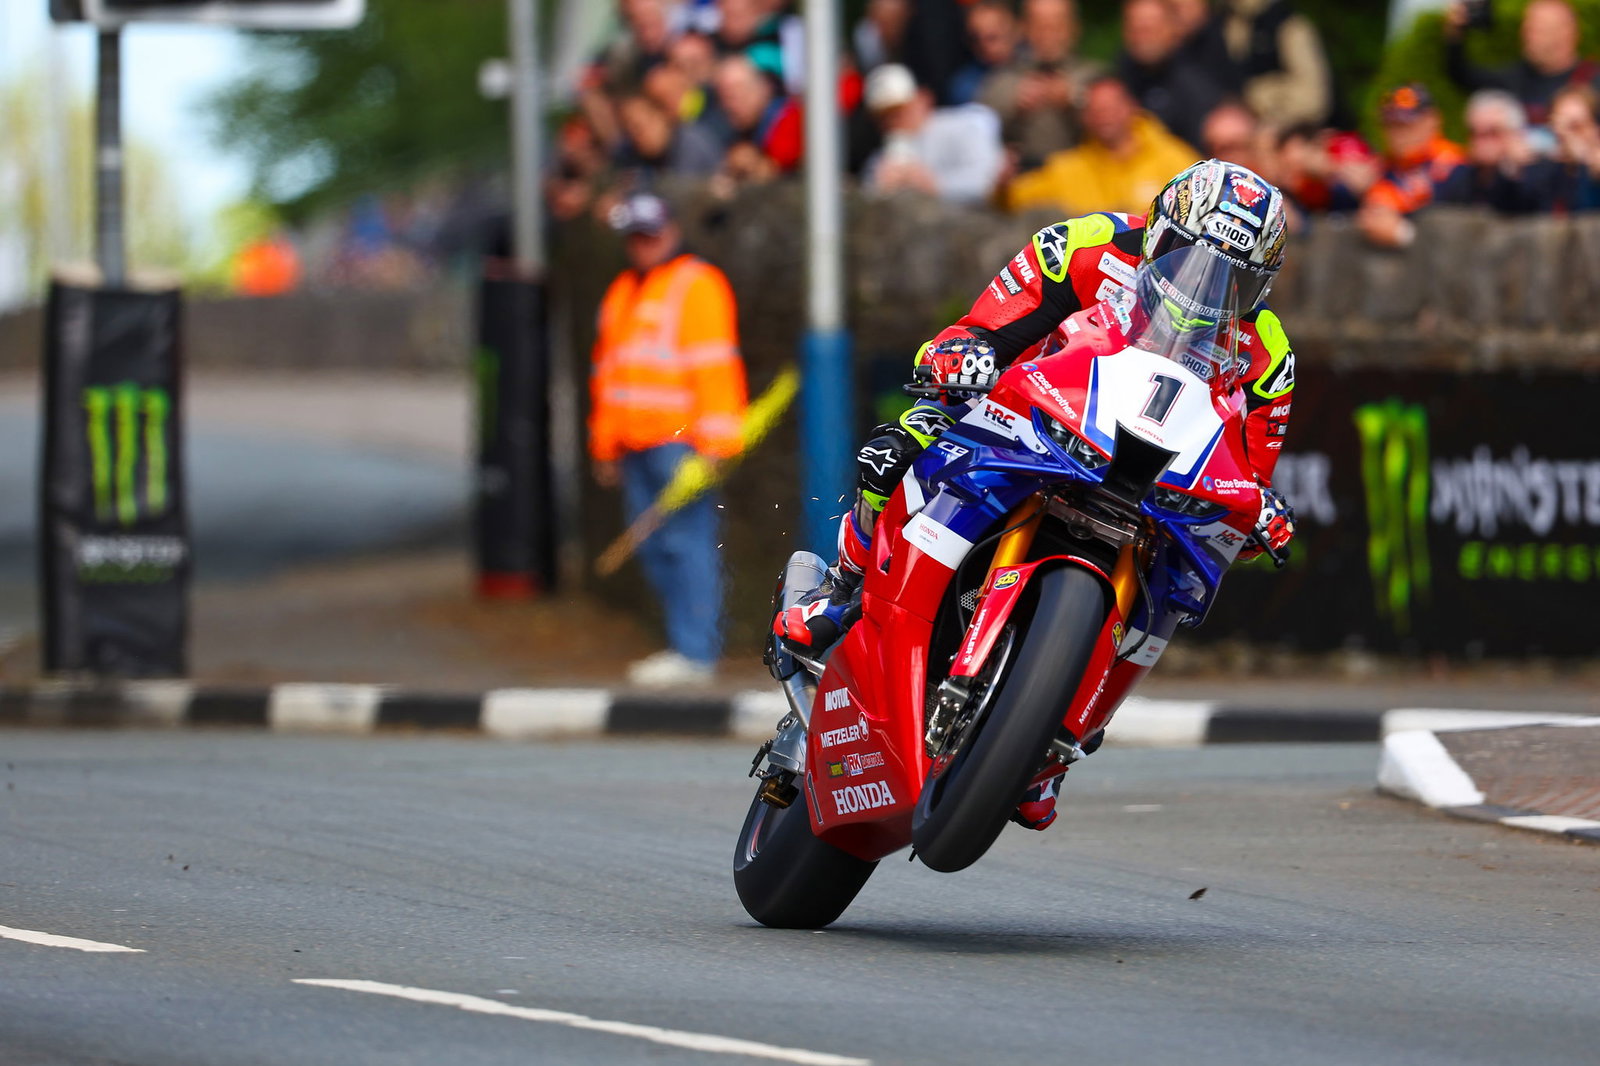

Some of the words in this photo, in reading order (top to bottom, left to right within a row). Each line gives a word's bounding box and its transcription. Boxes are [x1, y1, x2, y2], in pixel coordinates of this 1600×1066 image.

[1214, 221, 1251, 247] SHOEI
[1014, 250, 1036, 284] OTUL
[1207, 244, 1248, 270] Bennetts
[1179, 354, 1210, 378] SHOEI
[1032, 370, 1052, 391] Close
[1049, 388, 1077, 420] Brothers
[1140, 373, 1184, 425] 1
[984, 404, 1015, 430] HRC
[1133, 425, 1165, 444] HONDA
[1214, 478, 1234, 488] Close
[995, 572, 1018, 587] sbs
[966, 609, 987, 654] METZELER
[825, 687, 850, 711] MOTUL
[1079, 679, 1105, 724] METZELER
[821, 724, 860, 748] METZELER
[847, 754, 862, 770] RK
[832, 781, 896, 815] HONDA
